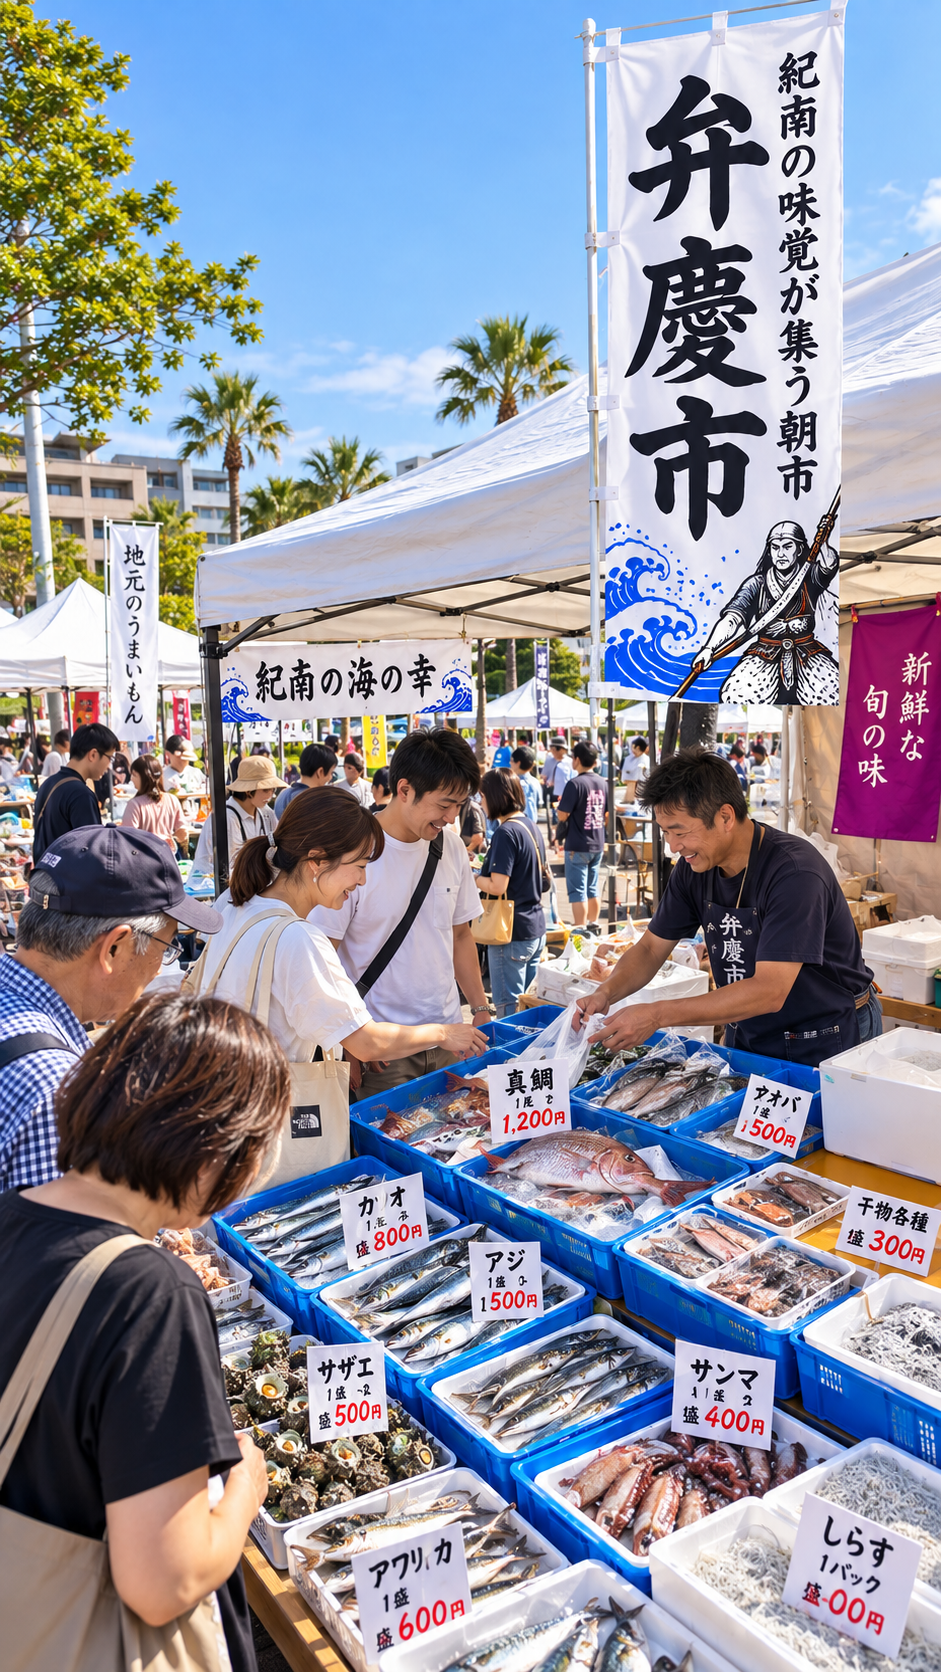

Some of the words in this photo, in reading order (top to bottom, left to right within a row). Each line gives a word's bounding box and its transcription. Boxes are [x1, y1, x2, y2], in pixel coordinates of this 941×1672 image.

[777, 51, 821, 501] 紀南の味覚が集う朝市
[624, 75, 770, 542] 弁慶市
[123, 544, 147, 726] 地元のうまいもん
[255, 653, 437, 704] 紀南の海の幸
[899, 652, 932, 762] 新鮮な
[858, 684, 889, 788] 旬の味
[719, 912, 747, 985] 弁慶市
[505, 1067, 554, 1097] 真鯛
[502, 1108, 566, 1135] 1,200円
[857, 1196, 930, 1234] 干物各種
[485, 1248, 526, 1274] アジ
[317, 1354, 375, 1385] サザエ
[690, 1358, 759, 1391] サンマ
[823, 1514, 894, 1568] しらす
